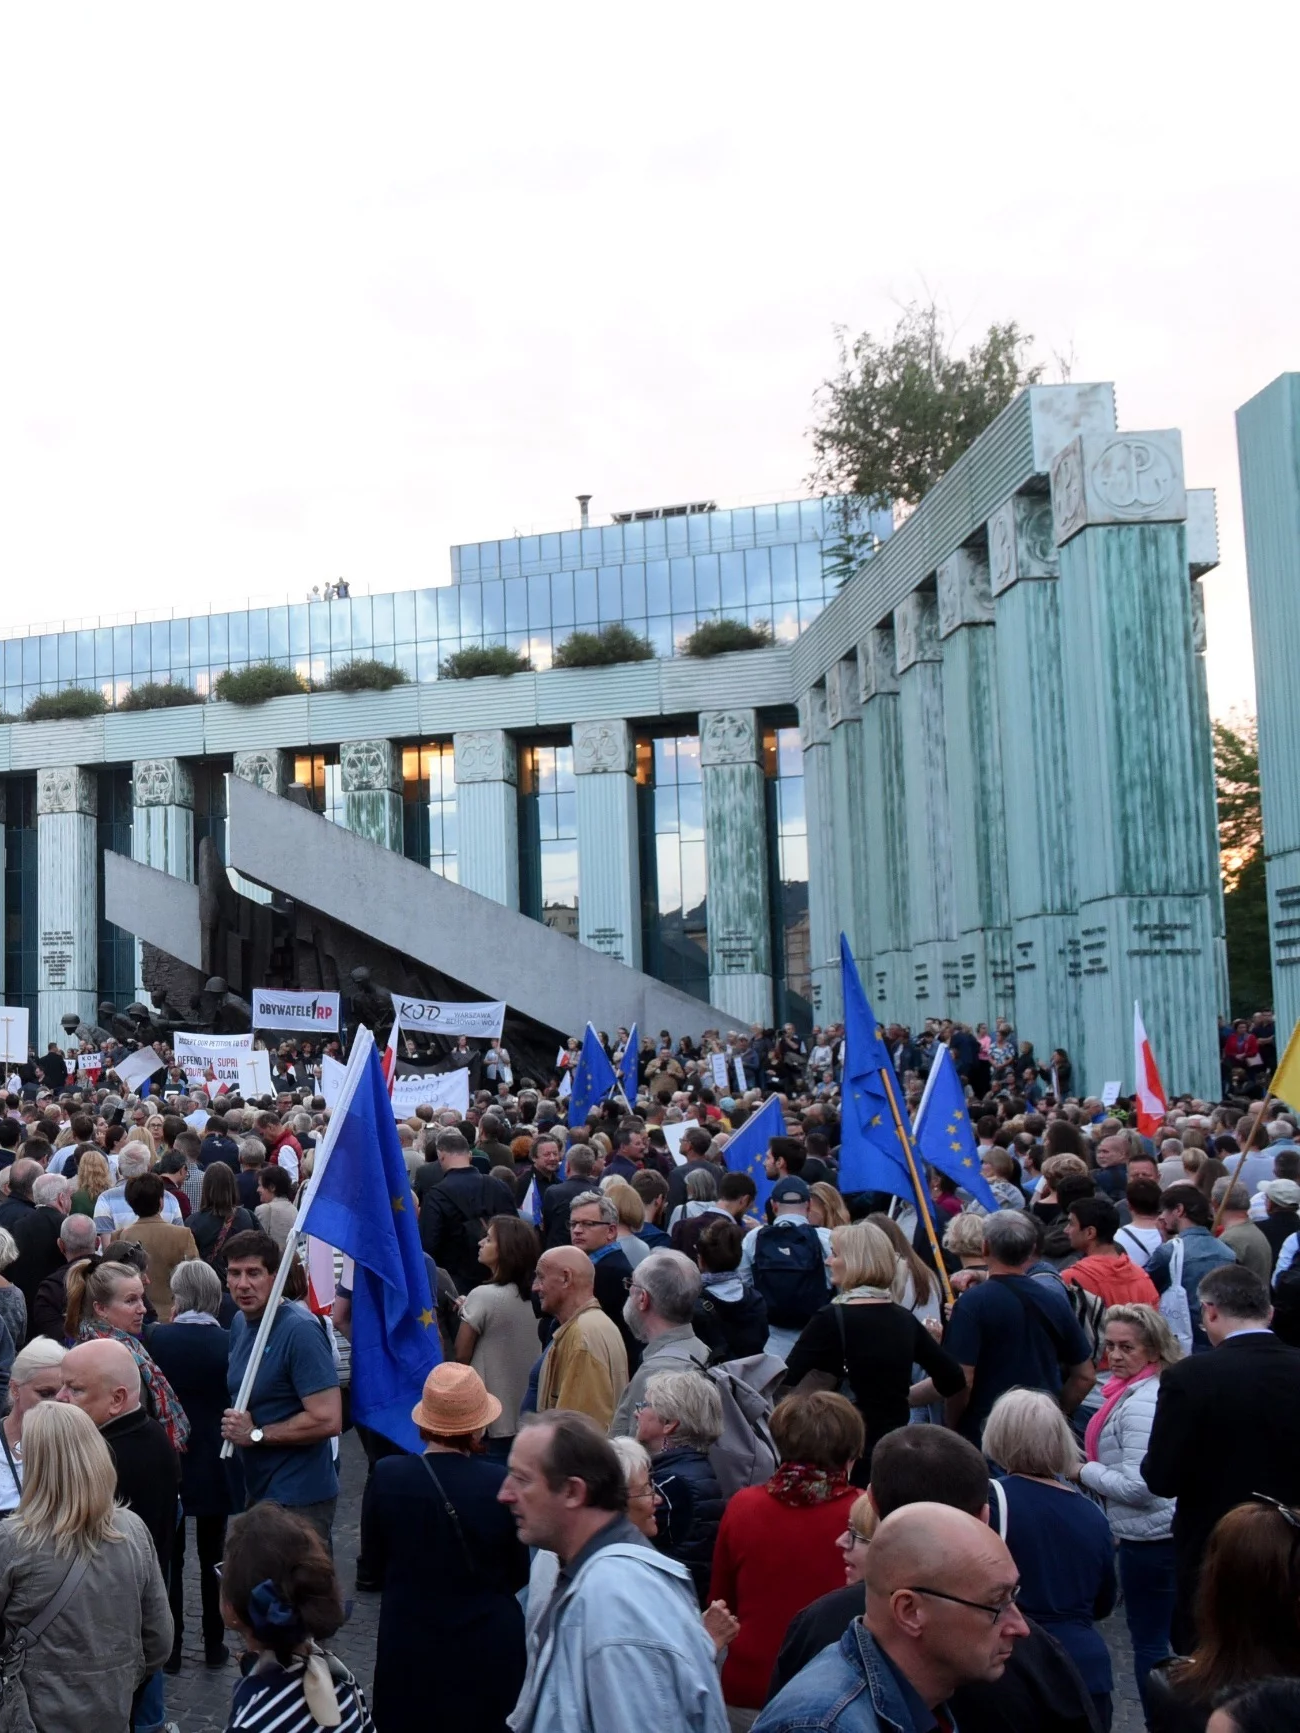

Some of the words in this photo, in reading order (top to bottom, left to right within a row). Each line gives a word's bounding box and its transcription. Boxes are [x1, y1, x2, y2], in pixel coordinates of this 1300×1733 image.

[259, 1003, 311, 1017] OBYWATELE
[317, 1006, 333, 1019] RP
[400, 1002, 441, 1021] KOD
